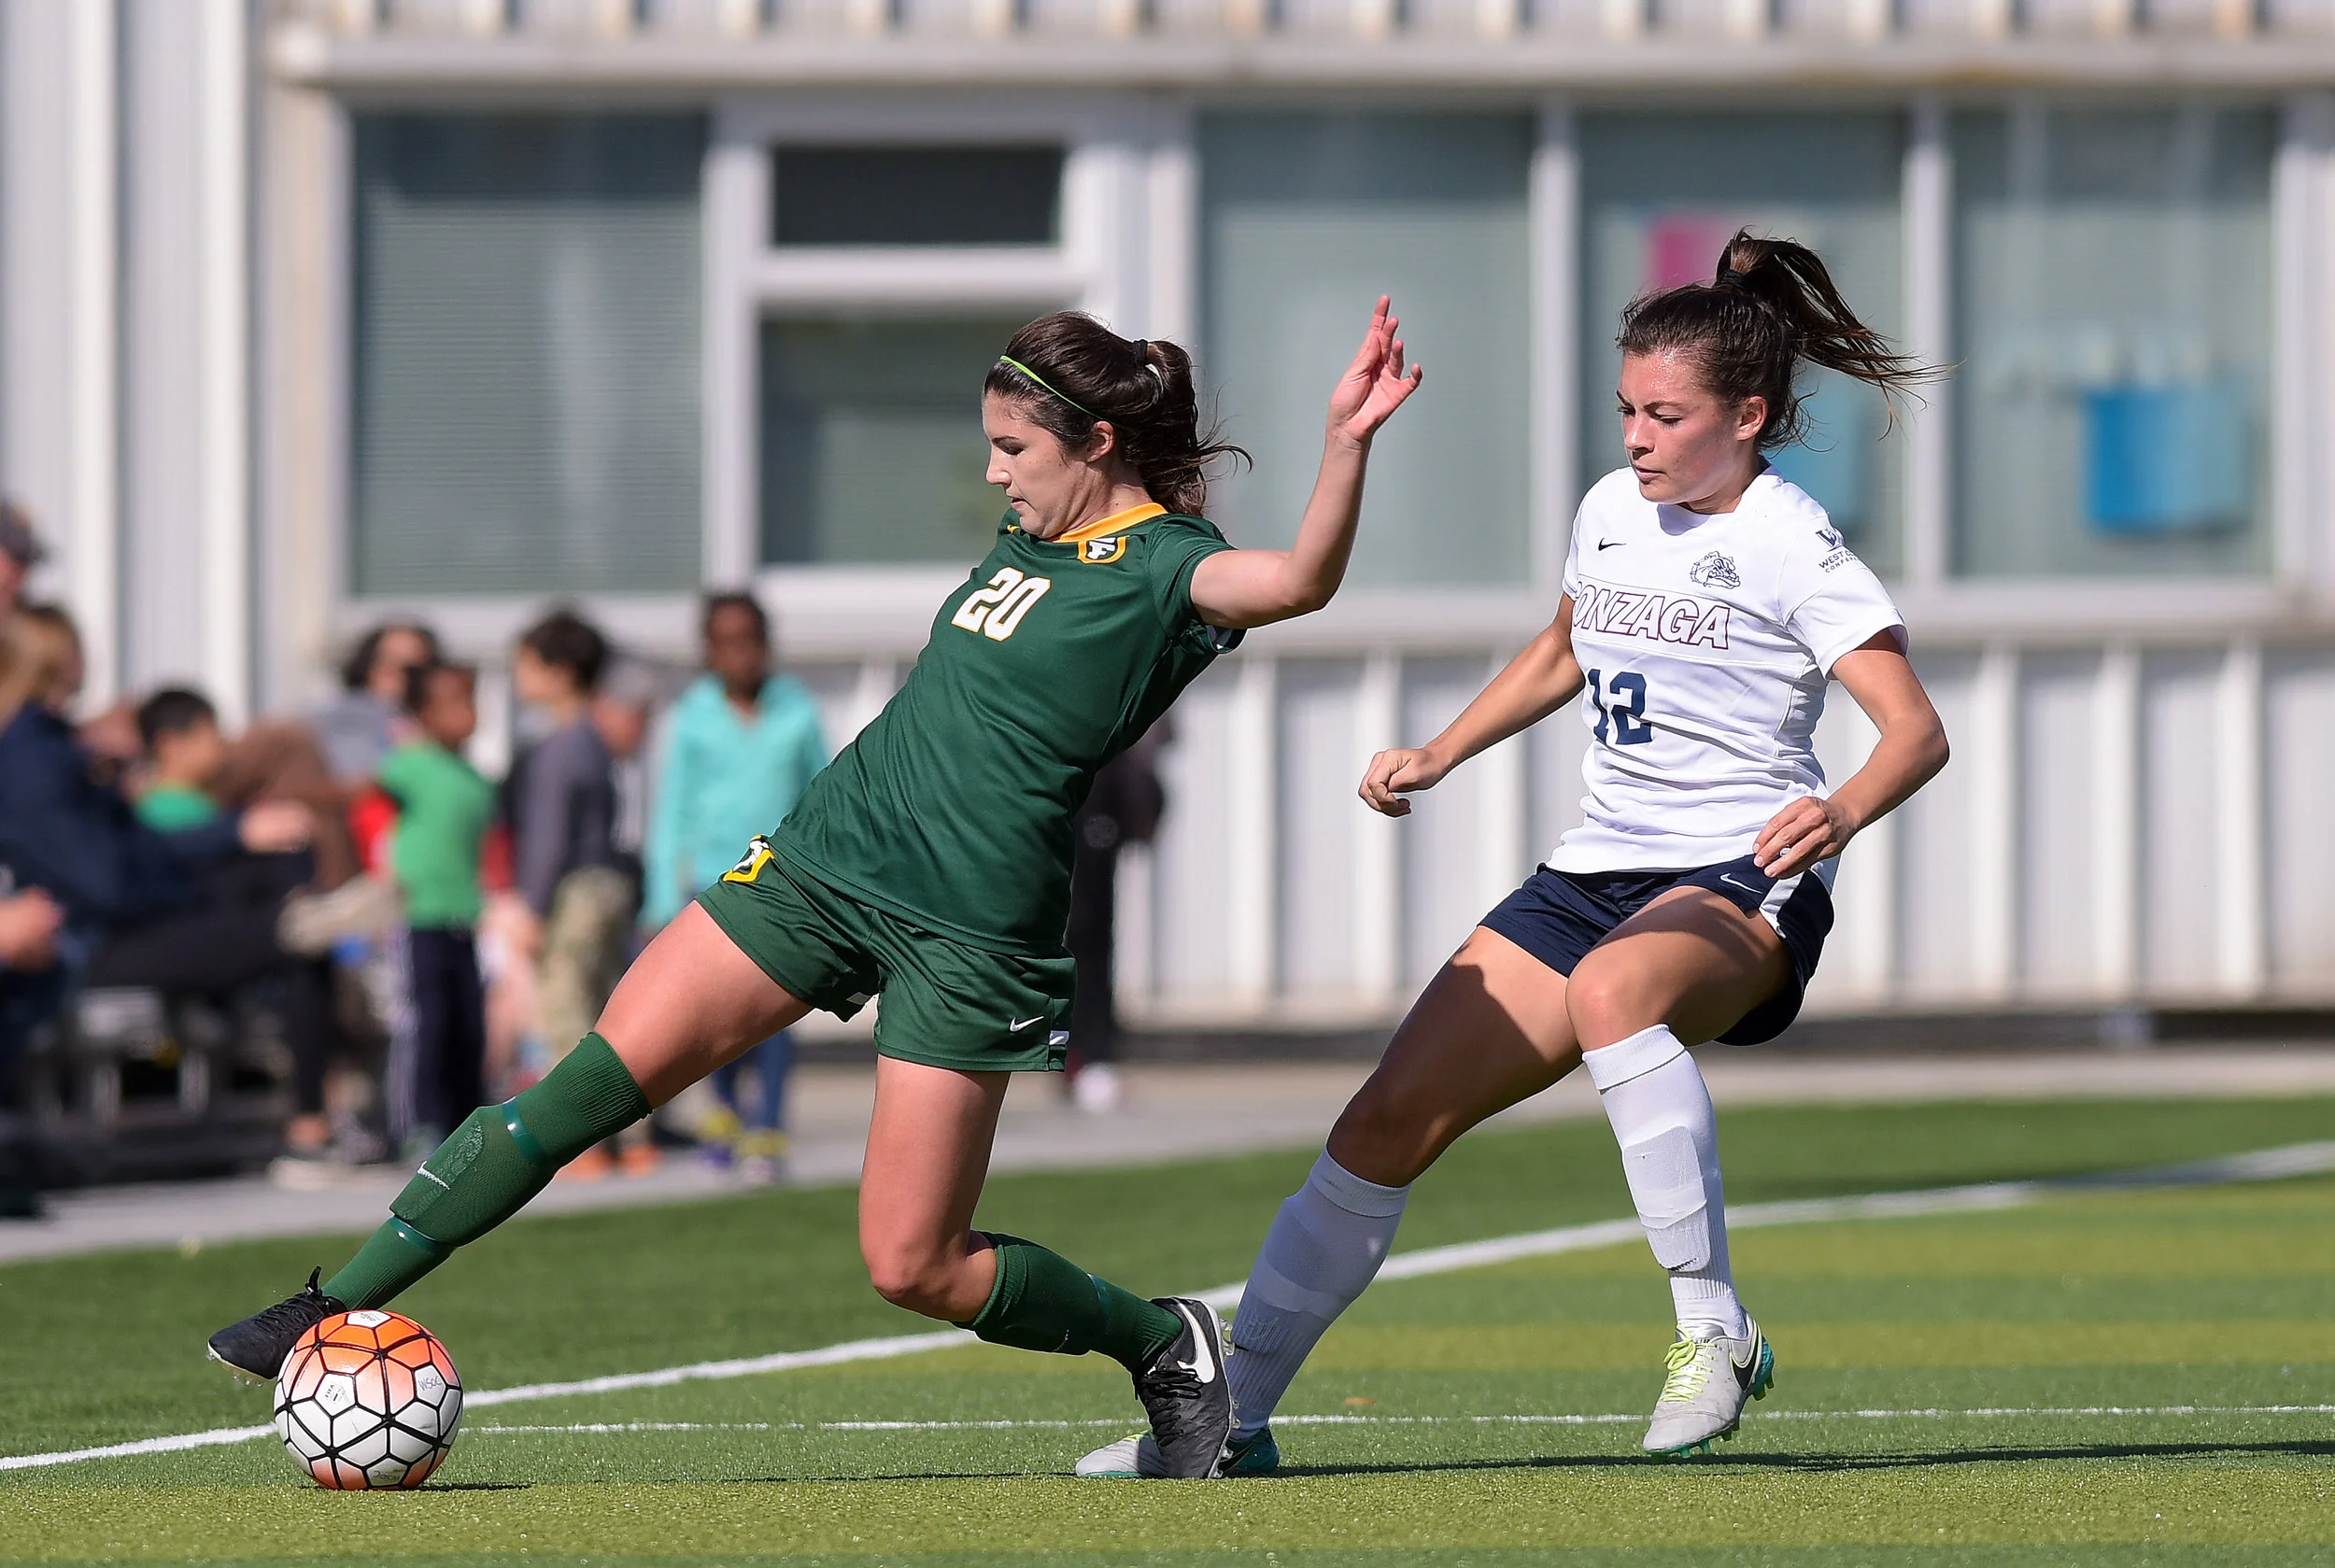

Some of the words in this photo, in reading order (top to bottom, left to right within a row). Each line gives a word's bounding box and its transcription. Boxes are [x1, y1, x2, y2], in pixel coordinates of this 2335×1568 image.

[1818, 550, 1844, 569] WEST
[950, 566, 1052, 643] 20
[1573, 581, 1730, 650] ONZAGA
[1588, 667, 1652, 746] 12
